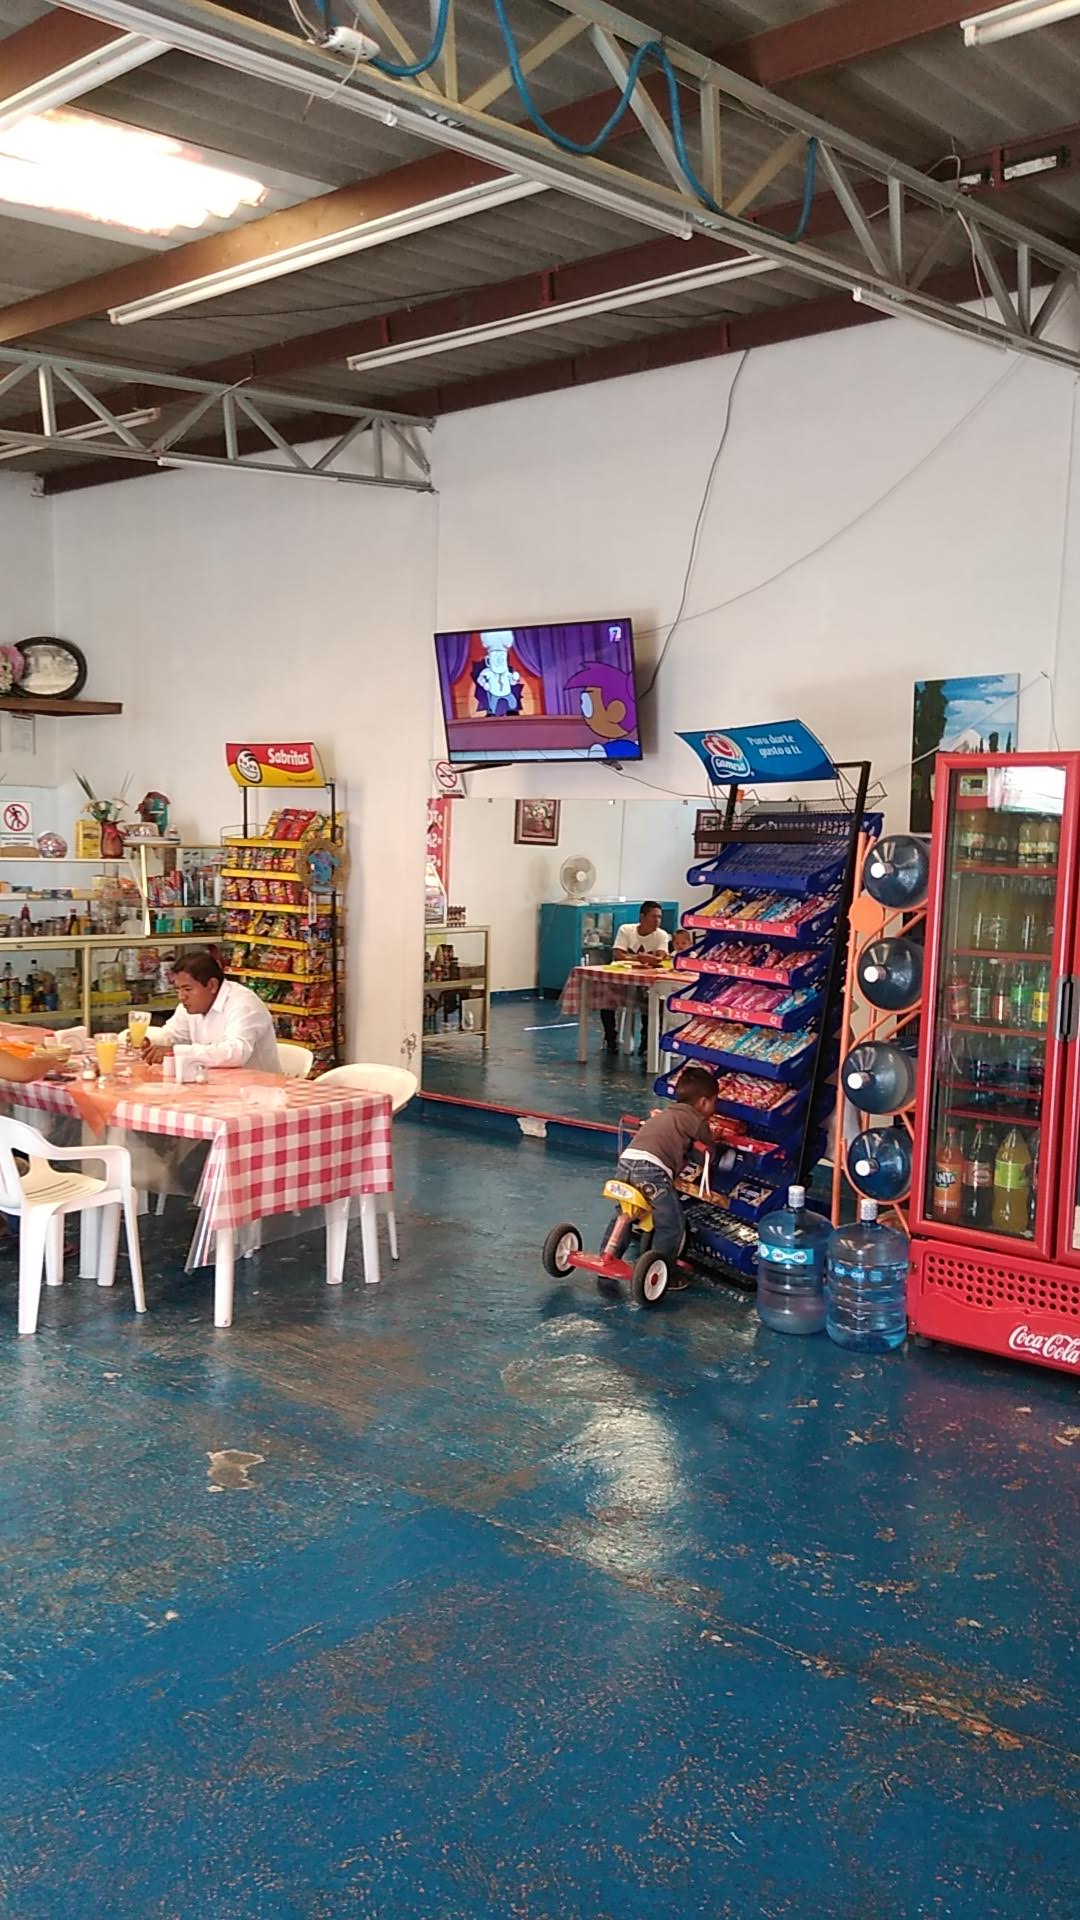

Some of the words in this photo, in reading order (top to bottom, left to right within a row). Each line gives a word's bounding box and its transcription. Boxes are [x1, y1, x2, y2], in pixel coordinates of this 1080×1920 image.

[746, 736, 770, 745] Para
[768, 734, 795, 744] darte
[267, 748, 309, 765] Sabritas
[759, 746, 784, 758] gusto
[715, 758, 746, 772] Gamesa
